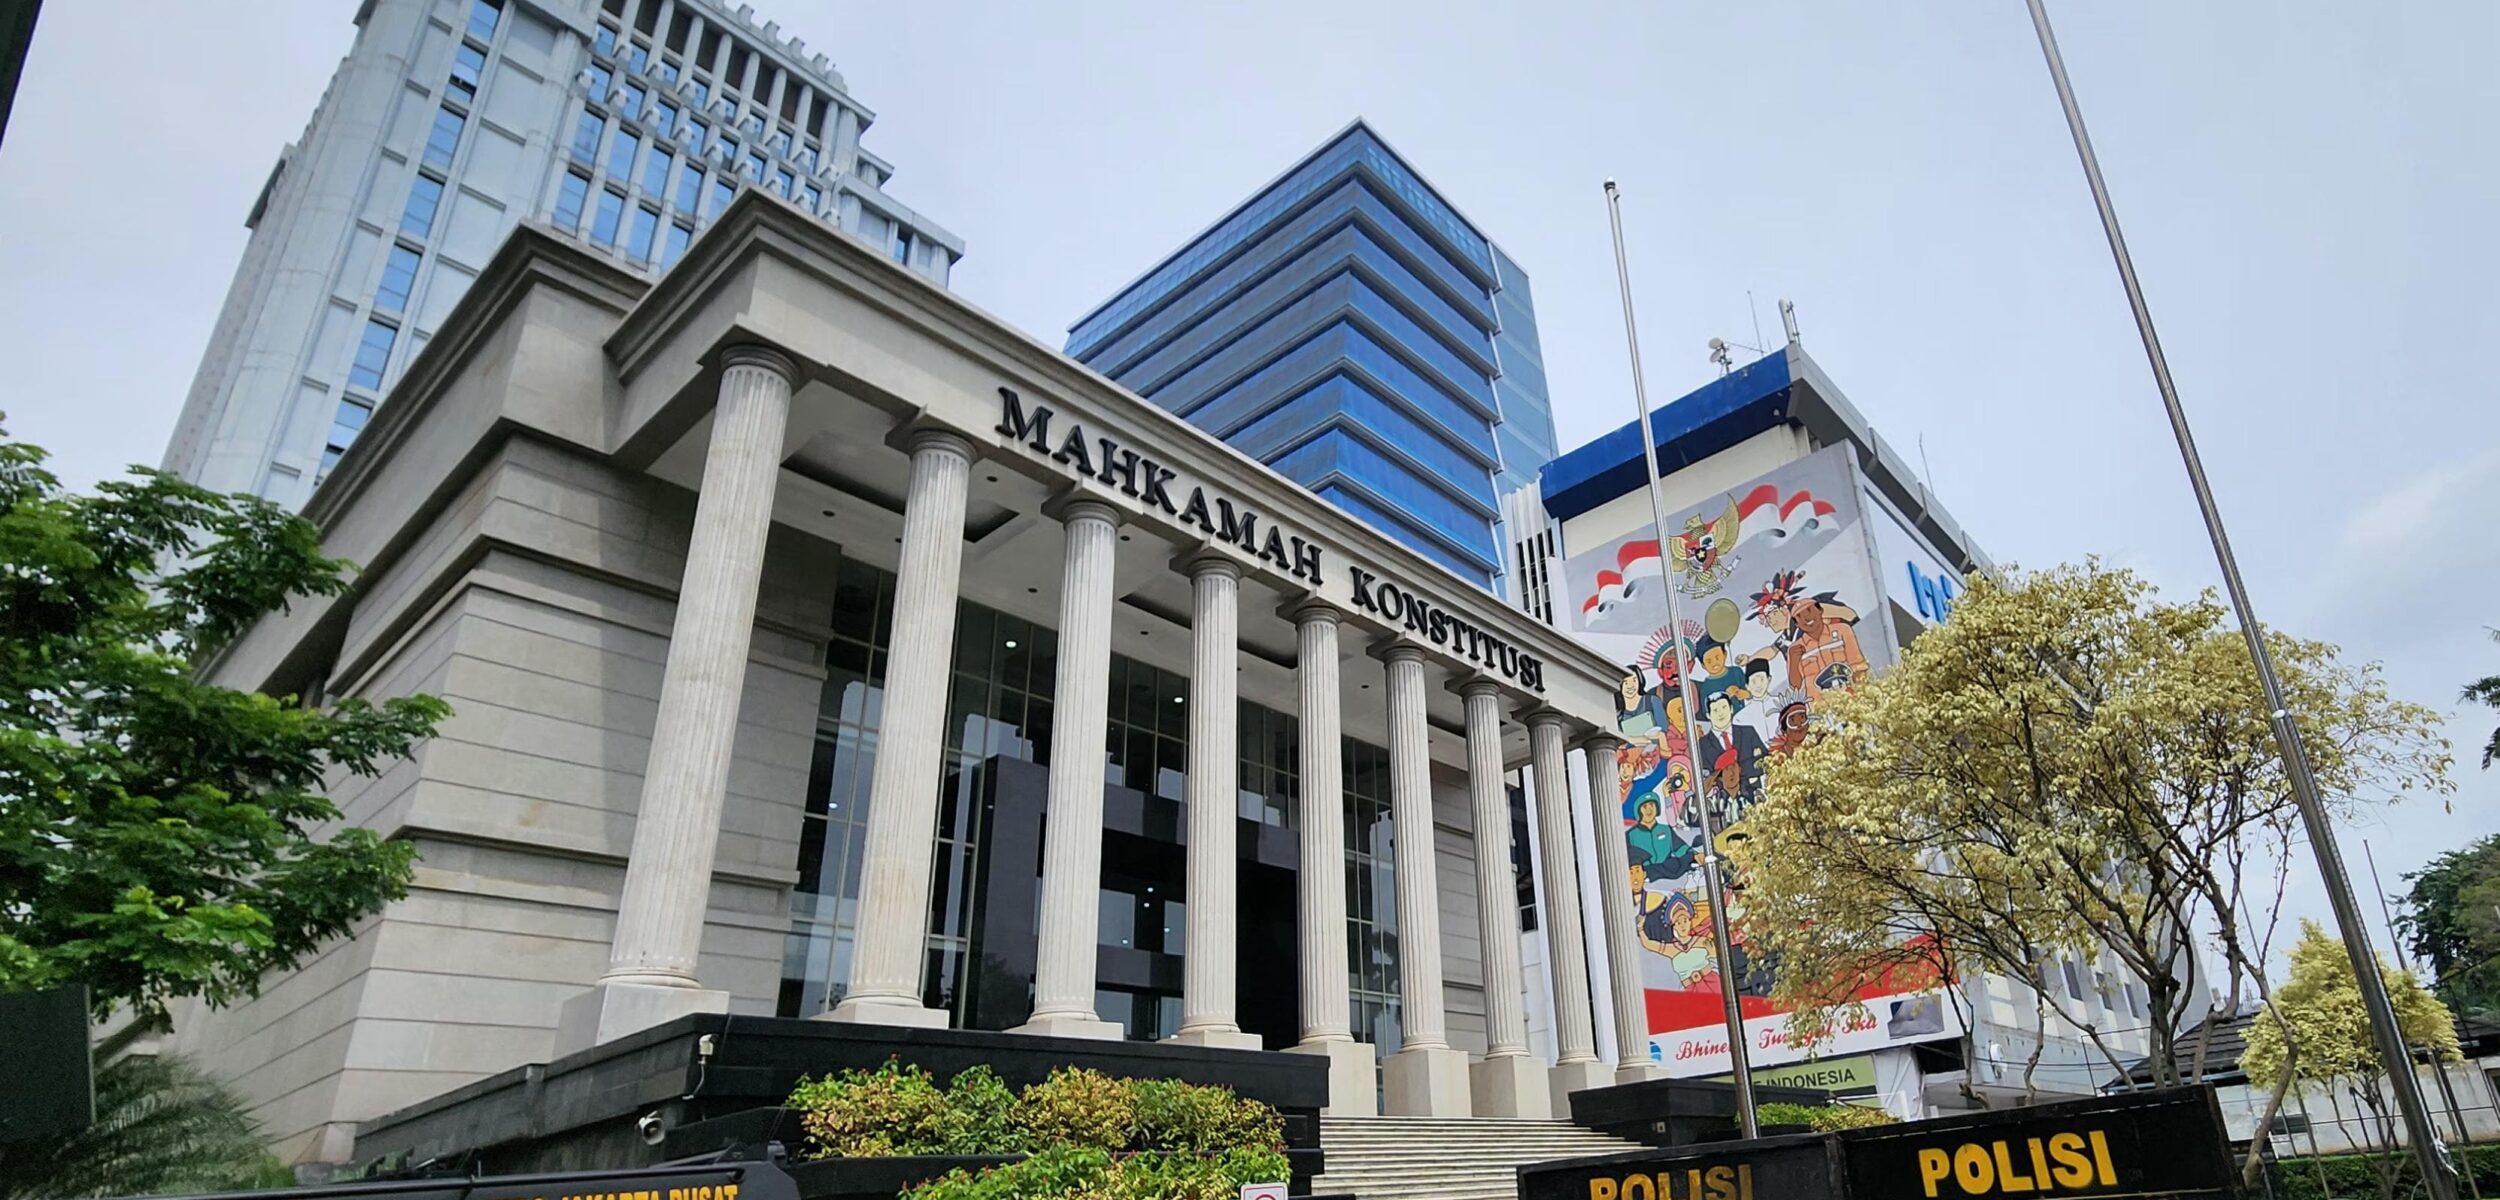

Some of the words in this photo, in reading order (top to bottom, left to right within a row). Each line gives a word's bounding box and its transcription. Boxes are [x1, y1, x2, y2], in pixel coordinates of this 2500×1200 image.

[995, 387, 1324, 586] MAHKAMAH
[1349, 566, 1545, 692] KONSTITUSI
[1675, 1039, 1746, 1060] Bhine
[1767, 1068, 1856, 1088] INDONESIA
[1590, 1164, 1755, 1200] POLISI
[1918, 1130, 2118, 1198] POLISI
